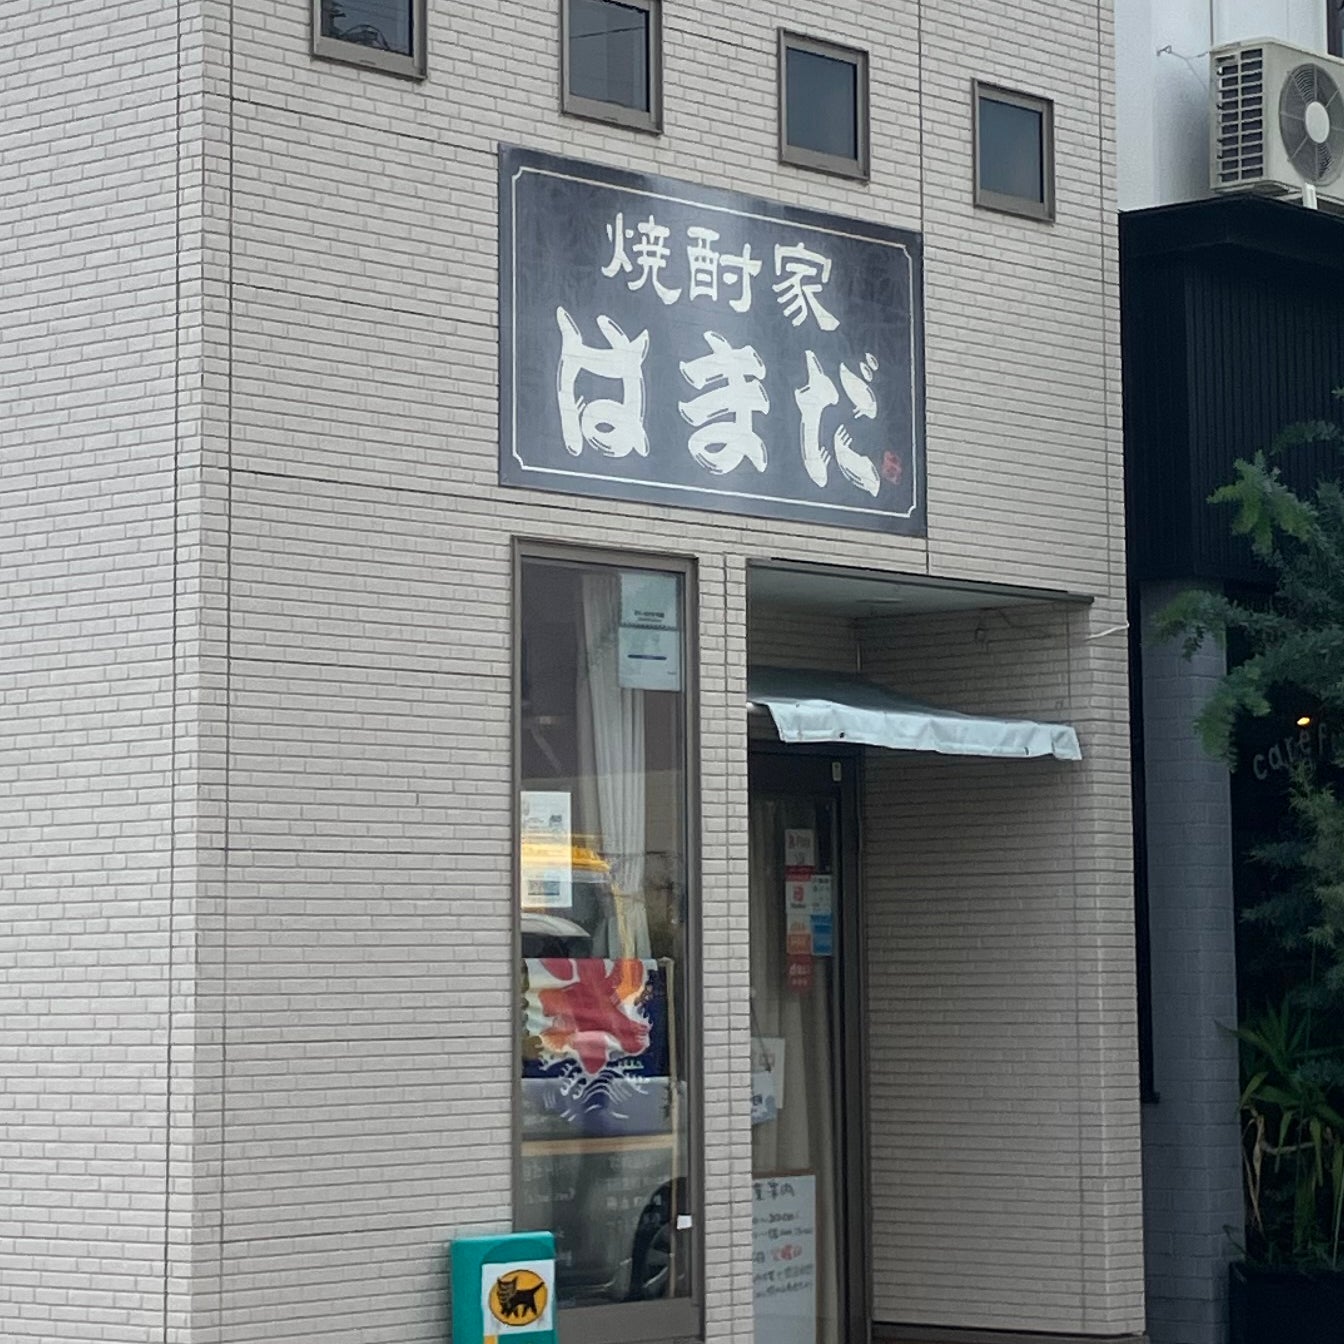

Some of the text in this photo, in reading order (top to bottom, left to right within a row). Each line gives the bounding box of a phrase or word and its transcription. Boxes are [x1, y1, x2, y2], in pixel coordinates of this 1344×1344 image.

[601, 212, 840, 331] 焼酎家
[556, 306, 881, 497] はまだ
